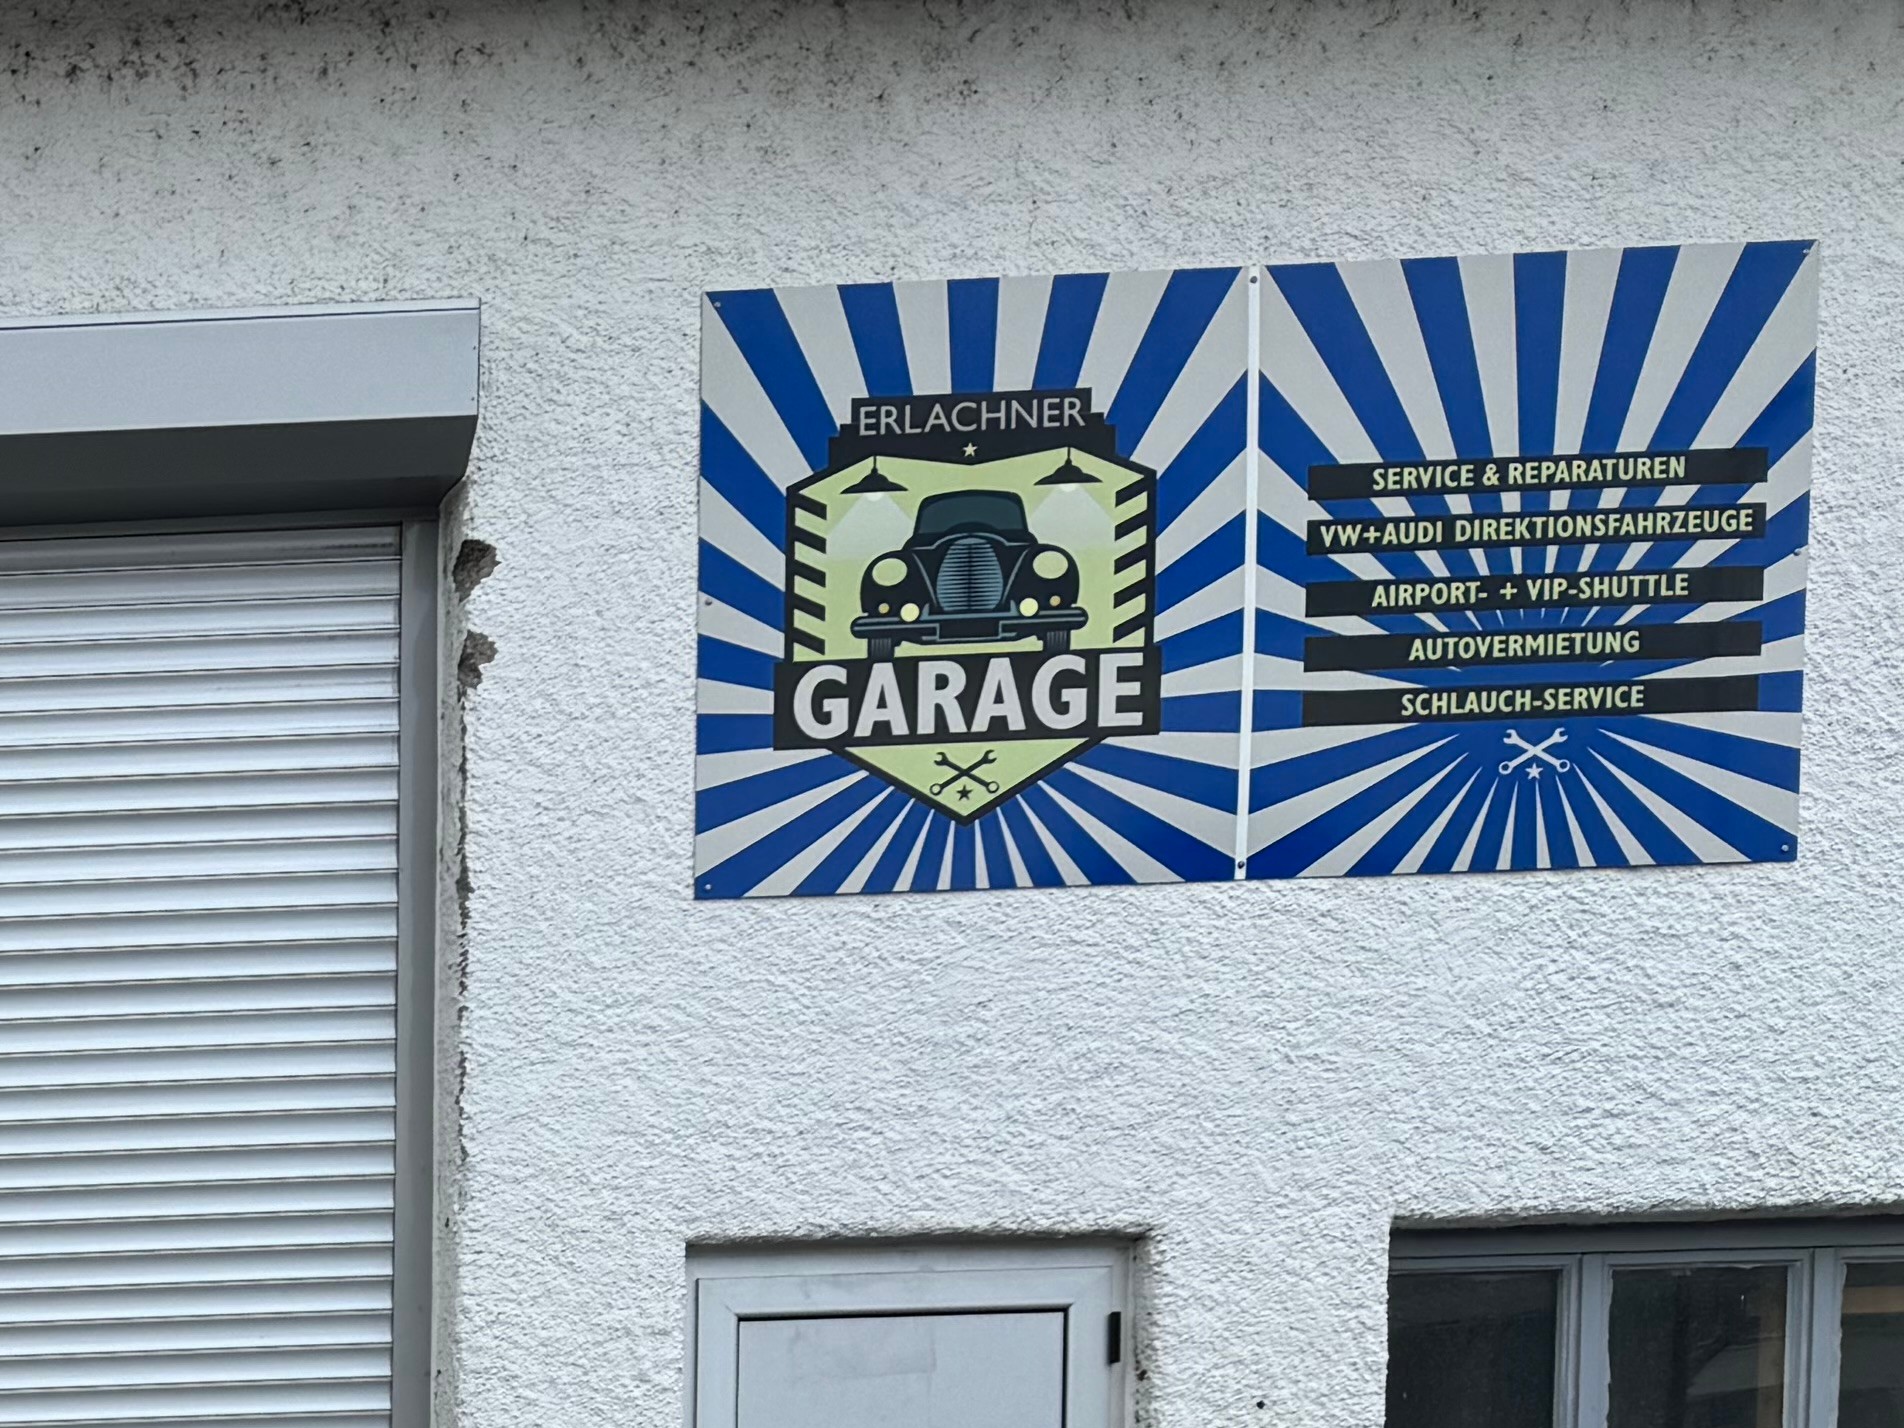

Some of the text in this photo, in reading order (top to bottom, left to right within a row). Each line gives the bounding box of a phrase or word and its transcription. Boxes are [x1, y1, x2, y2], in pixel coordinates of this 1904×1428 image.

[858, 397, 1086, 436] ERLACHNER
[1372, 456, 1687, 491] SERVICE & REPARATUREN
[1319, 509, 1754, 548] VW+AUDI DIREKTIONSFAHRZEUGE
[1371, 573, 1690, 608] AIRPORT- + VIP-SHUTTLE
[1408, 630, 1641, 662] AUTOVERMIETUNG
[792, 651, 1145, 741] GARAGE
[1400, 685, 1645, 717] SCHLAUCH-SERVICE
